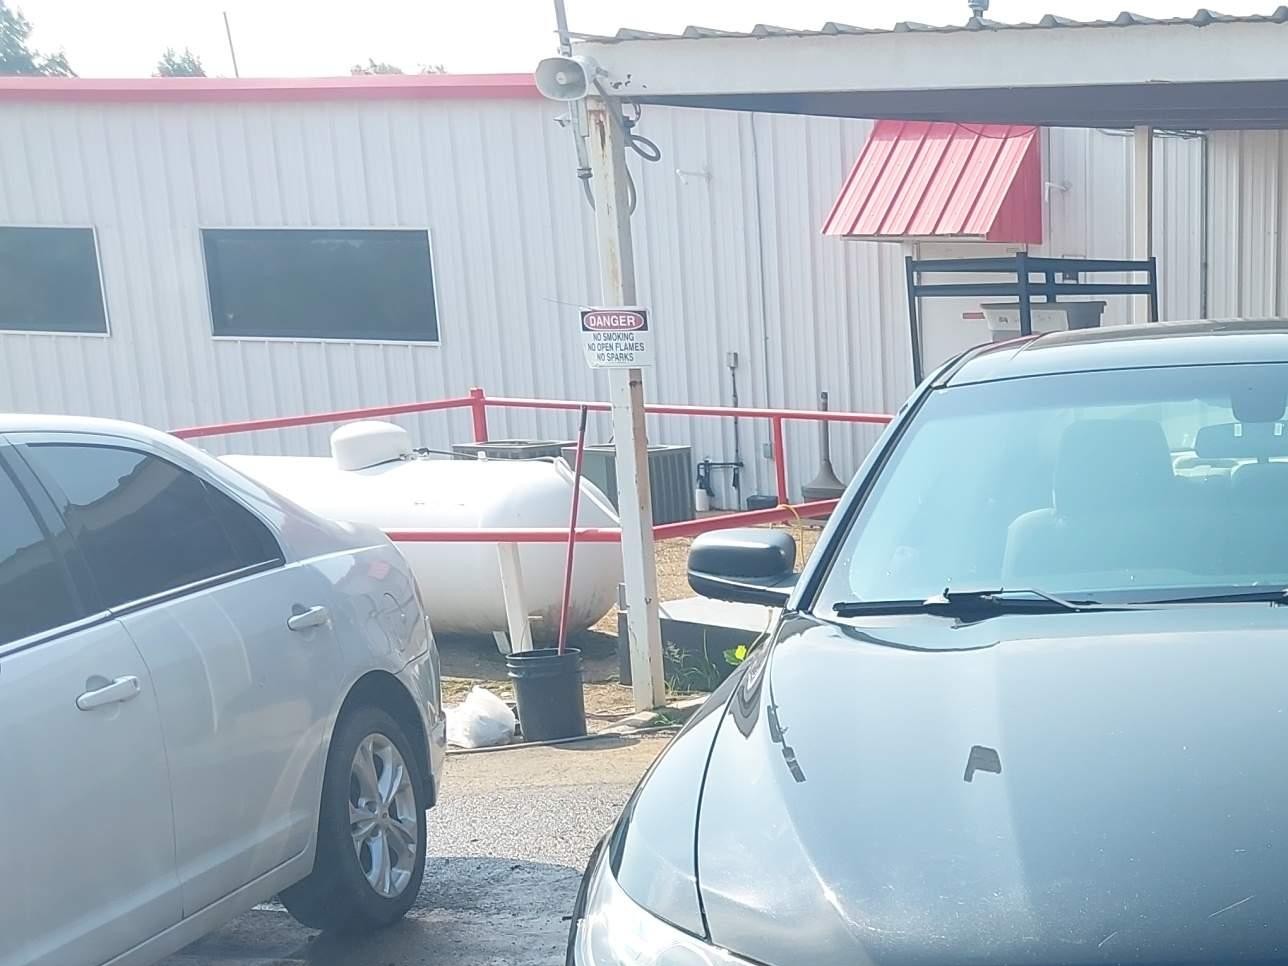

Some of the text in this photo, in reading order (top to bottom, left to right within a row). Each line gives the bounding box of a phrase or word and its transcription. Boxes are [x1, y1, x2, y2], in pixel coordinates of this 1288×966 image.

[589, 315, 636, 327] DANGER
[593, 332, 635, 342] NO SMOKING
[588, 343, 645, 351] NO OPEN FLAMES
[597, 353, 634, 361] NO SPARKS
